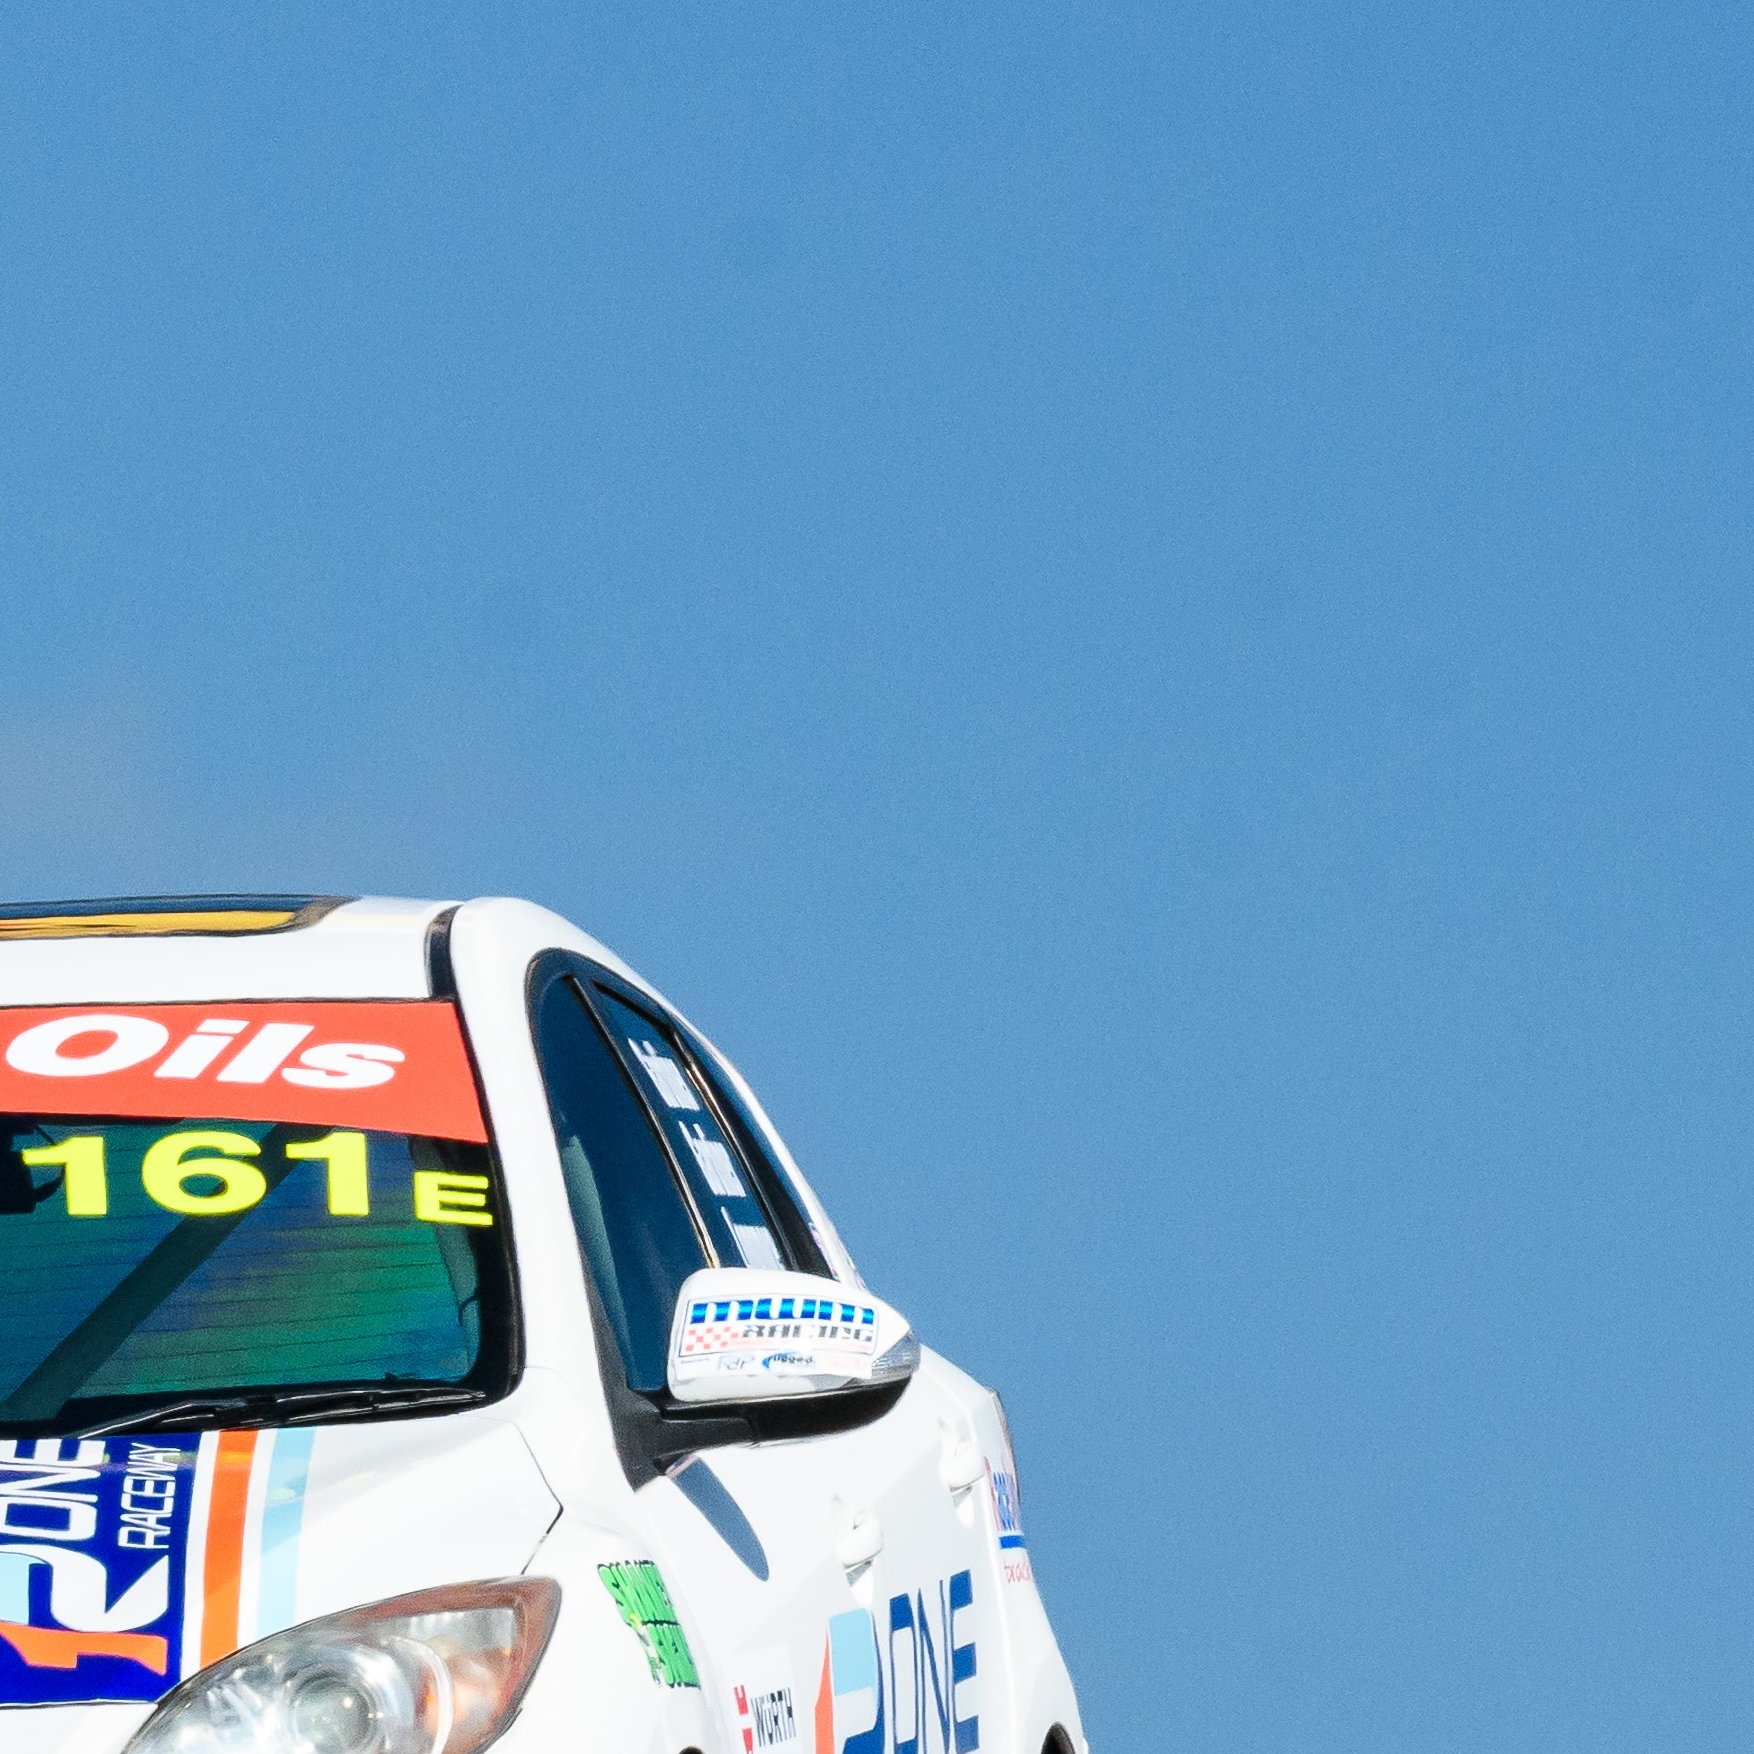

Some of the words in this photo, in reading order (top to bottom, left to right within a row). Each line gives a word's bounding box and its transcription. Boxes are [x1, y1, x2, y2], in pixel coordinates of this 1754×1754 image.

[4, 1014, 406, 1090] Oils
[21, 1130, 371, 1217] 161
[413, 1170, 494, 1226] E
[117, 1442, 191, 1549] RACEWAY
